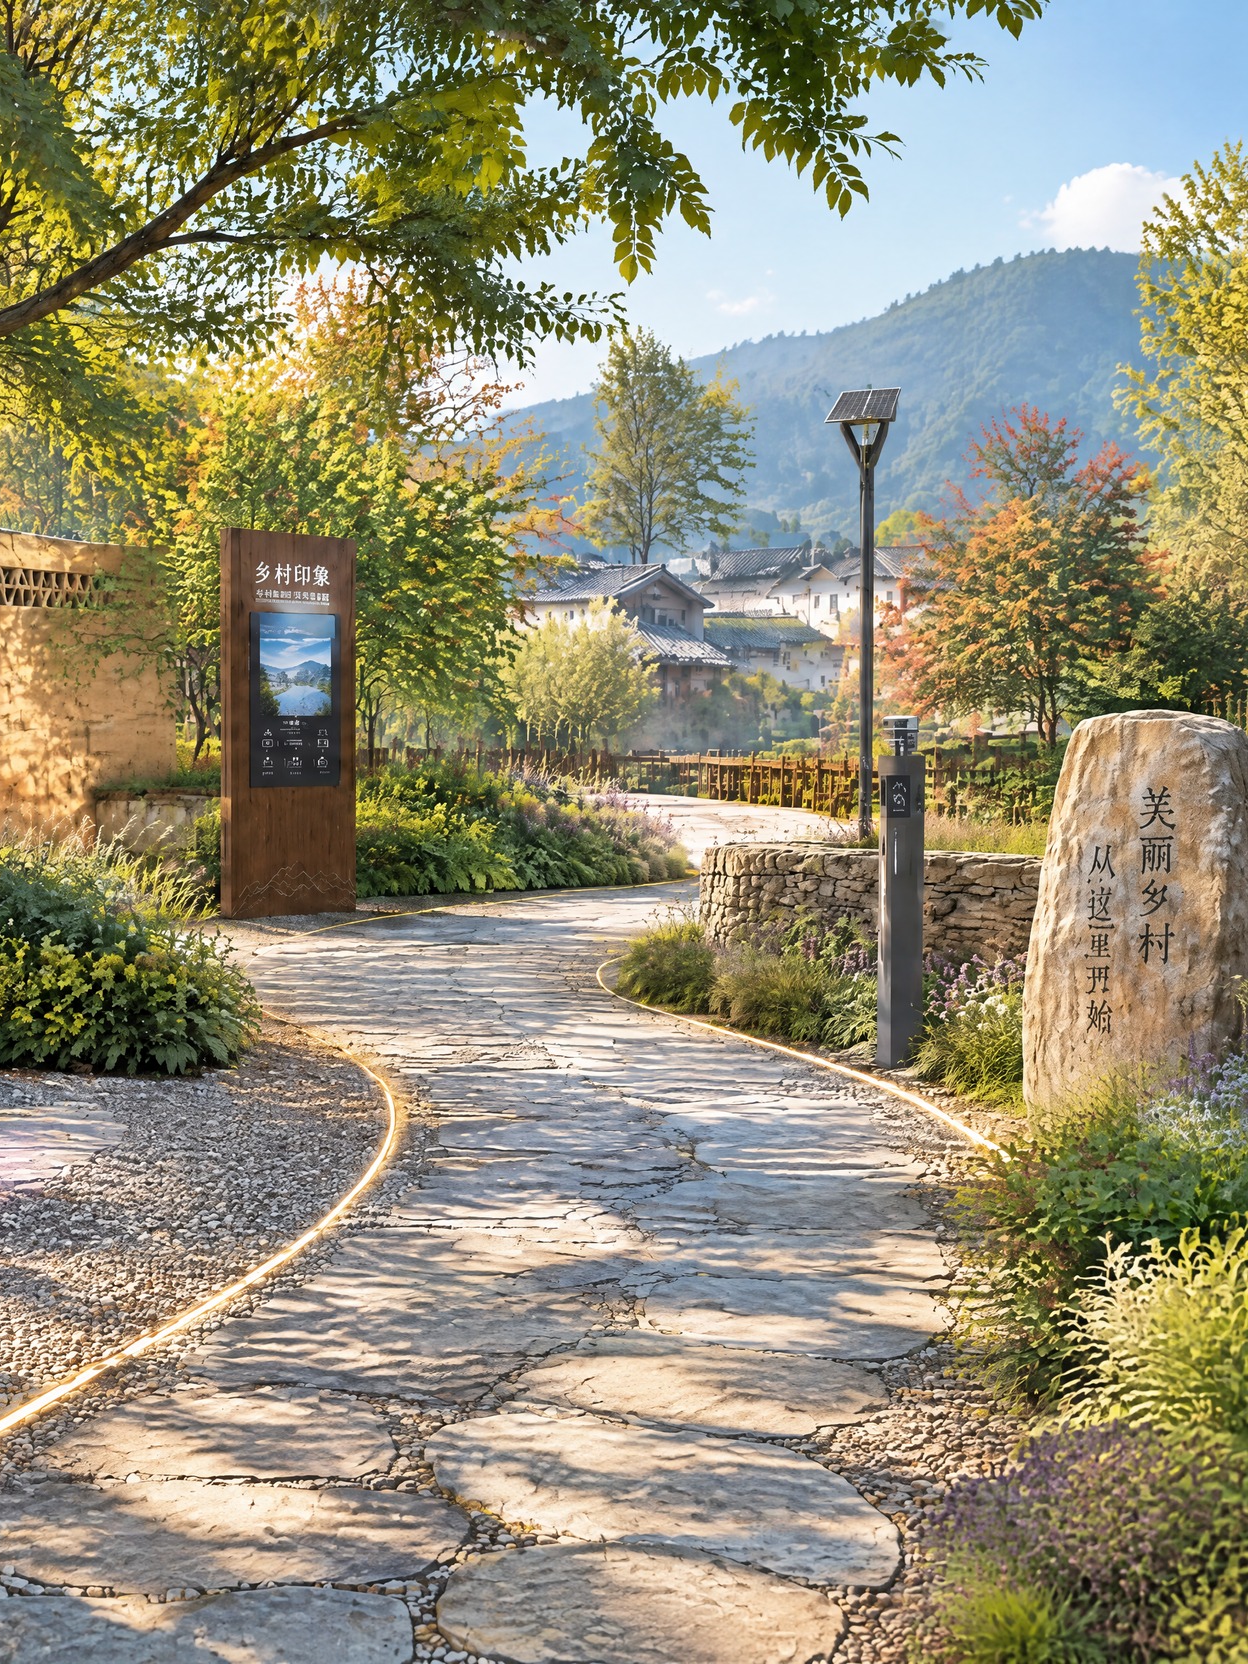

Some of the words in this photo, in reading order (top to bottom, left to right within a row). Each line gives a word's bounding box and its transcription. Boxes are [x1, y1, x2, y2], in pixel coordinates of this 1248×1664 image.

[255, 561, 330, 587] 乡村印象
[1138, 785, 1176, 965] 美丽乡村
